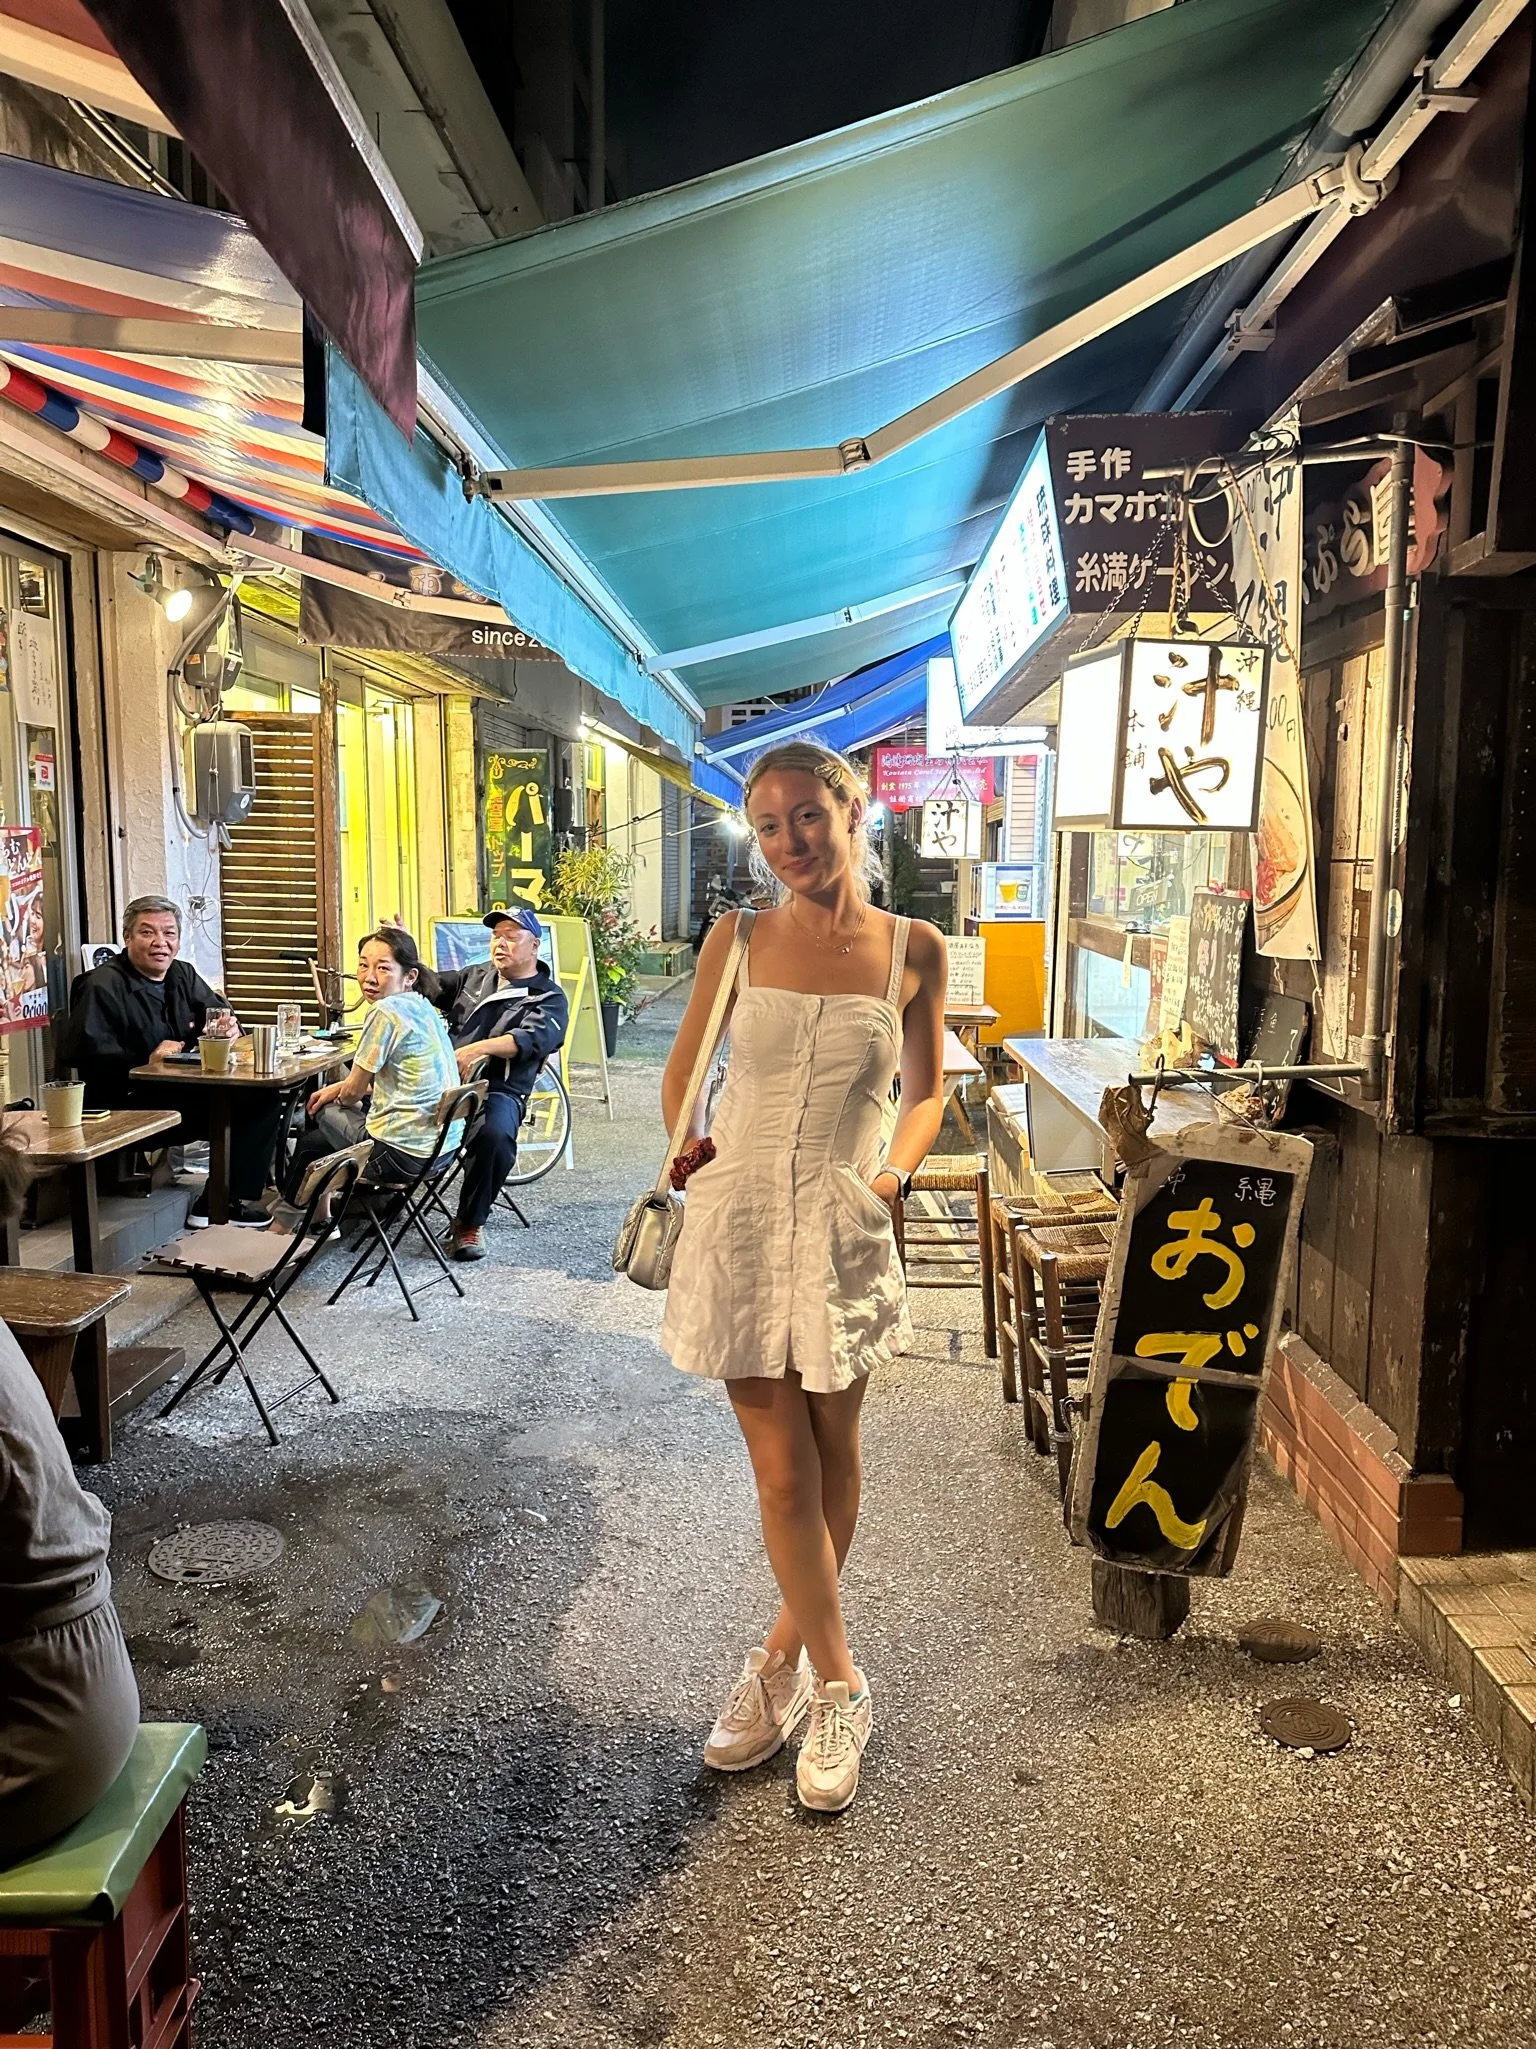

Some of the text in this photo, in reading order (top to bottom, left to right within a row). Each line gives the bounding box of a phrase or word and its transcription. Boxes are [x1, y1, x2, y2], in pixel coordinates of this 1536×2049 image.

[1066, 446, 1132, 482] 手作
[471, 626, 526, 647] since
[1235, 650, 1260, 713] 沖縄
[1149, 645, 1240, 825] 汁や
[505, 781, 547, 911] パーマ
[931, 800, 960, 857] 汁や
[23, 1000, 47, 1018] Orion
[1105, 1197, 1259, 1550] おでん
